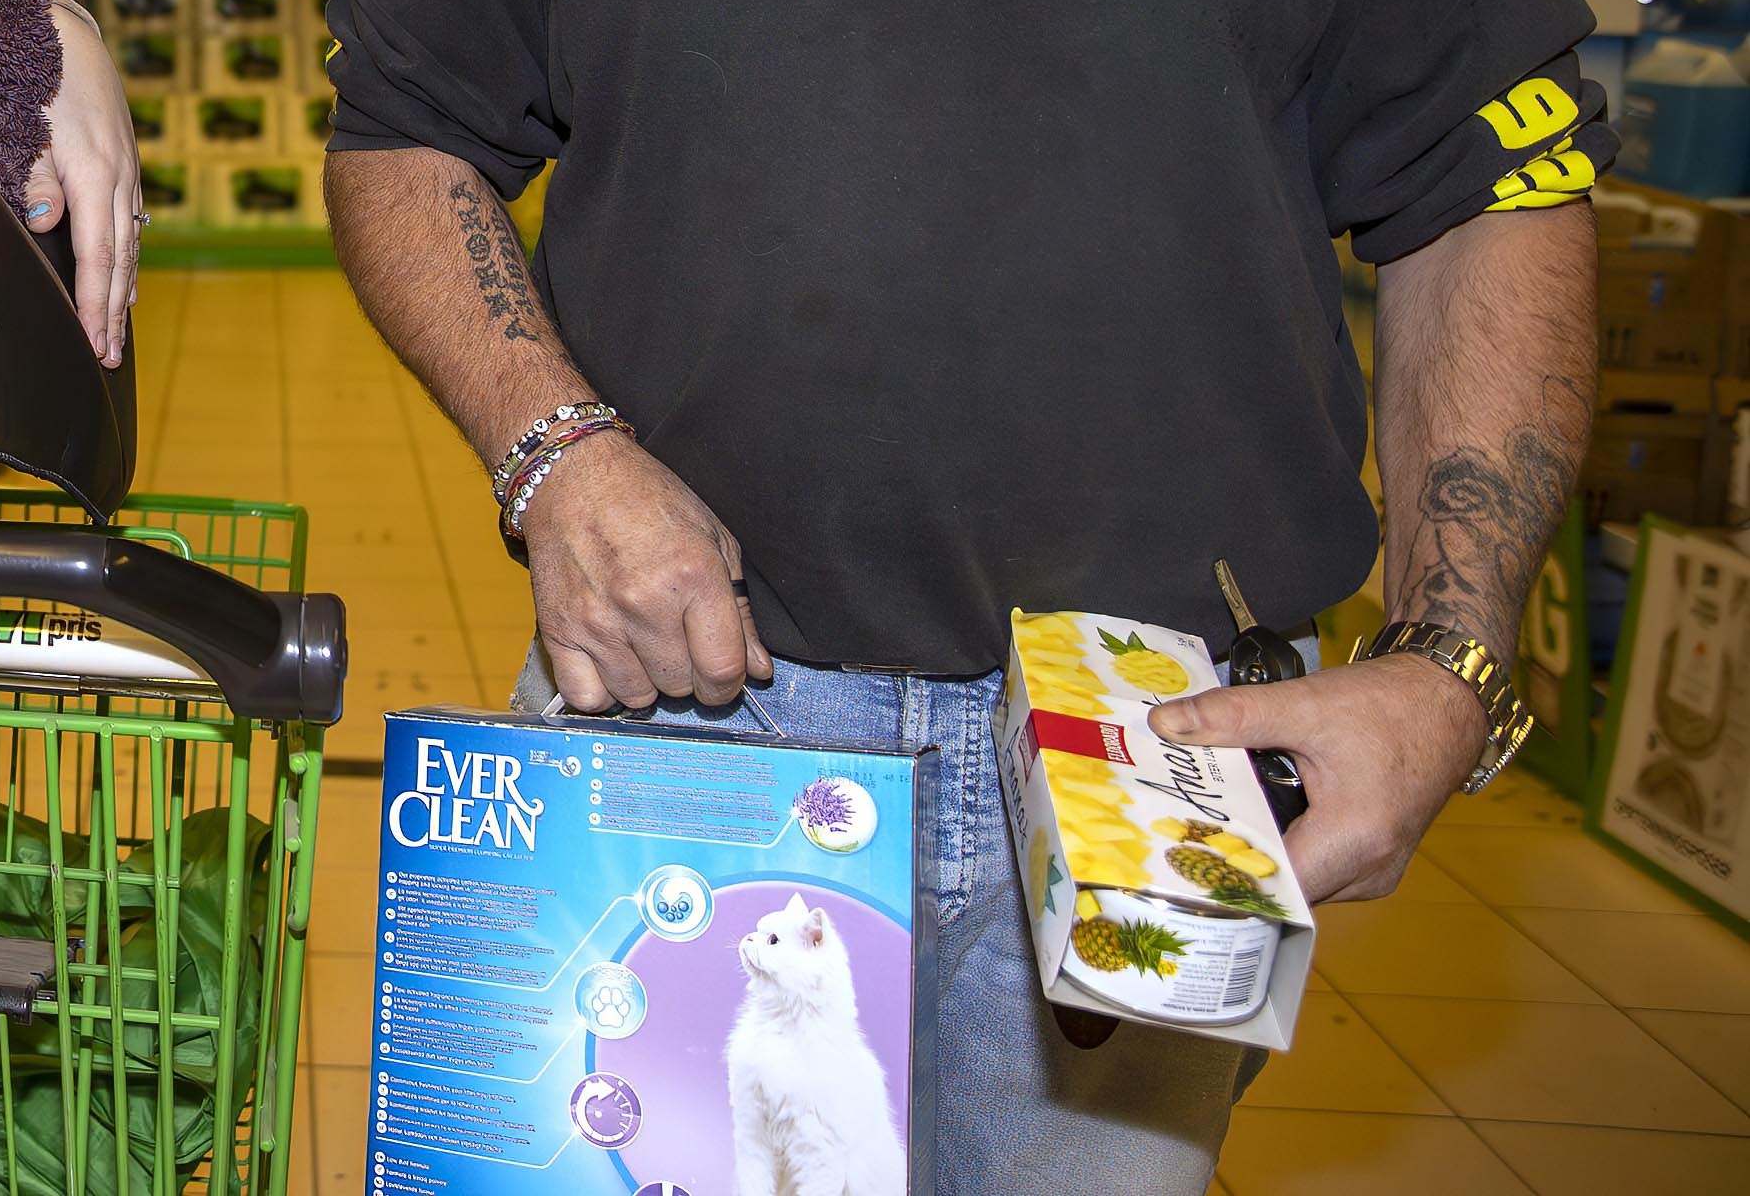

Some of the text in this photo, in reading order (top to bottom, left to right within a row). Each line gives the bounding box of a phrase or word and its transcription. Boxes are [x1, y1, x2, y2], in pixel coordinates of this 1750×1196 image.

[47, 610, 102, 647] pris
[415, 737, 545, 818] EVER
[388, 790, 538, 853] CLEAN
